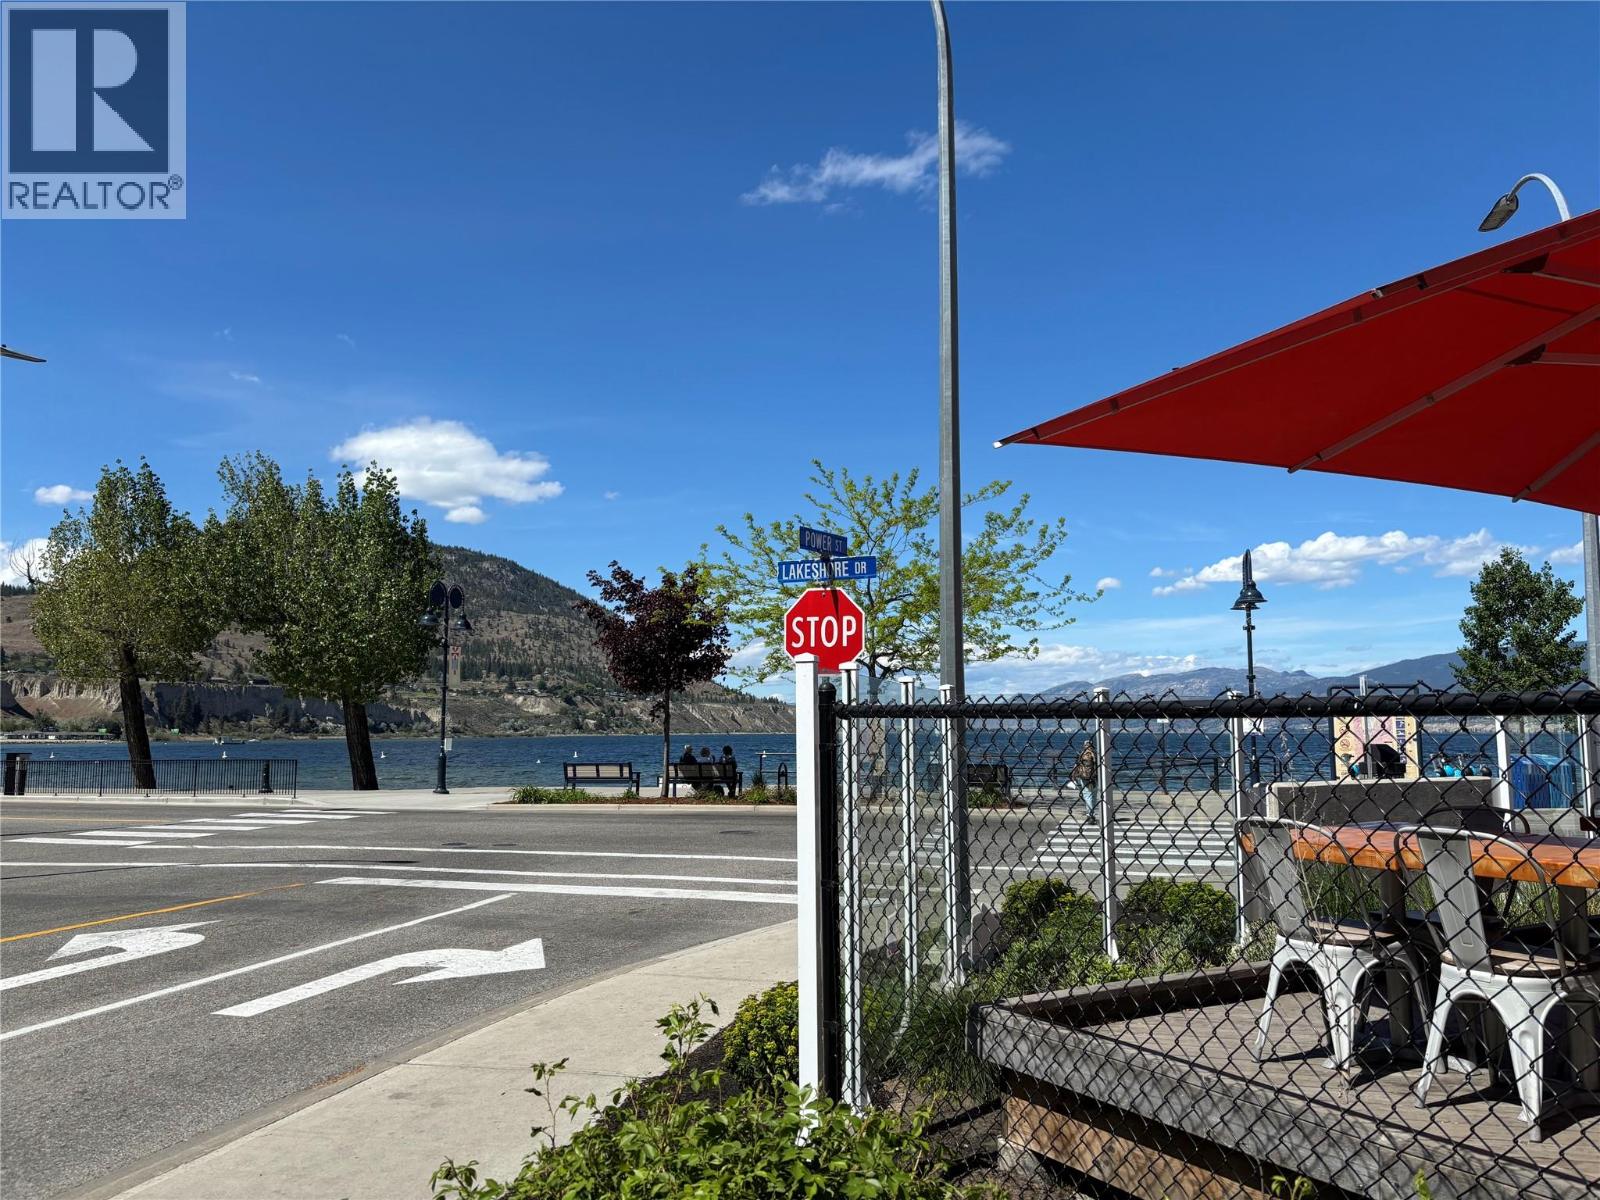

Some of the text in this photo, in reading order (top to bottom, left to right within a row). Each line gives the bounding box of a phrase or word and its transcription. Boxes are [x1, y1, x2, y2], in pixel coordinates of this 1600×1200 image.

[805, 530, 843, 552] POWER ST
[782, 560, 867, 580] LAKESHORE DR
[791, 615, 857, 648] STOP
